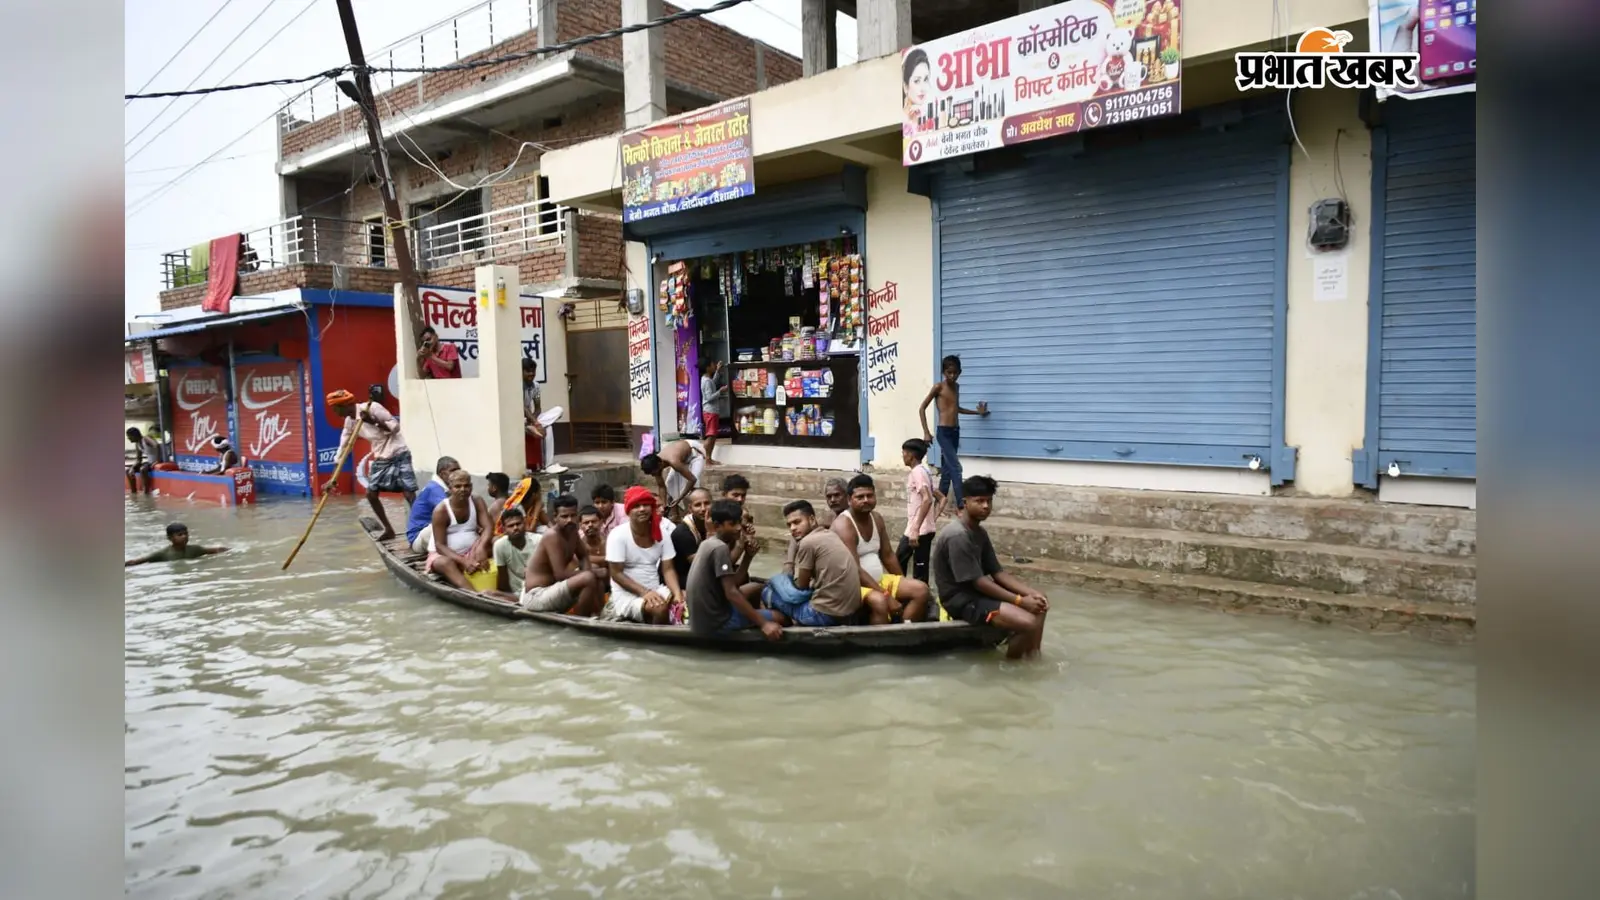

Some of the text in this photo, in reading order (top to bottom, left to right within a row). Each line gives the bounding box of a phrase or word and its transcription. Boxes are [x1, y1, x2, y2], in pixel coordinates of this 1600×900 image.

[1017, 15, 1098, 57] कॉस्मेटिक
[936, 35, 1012, 92] आभा
[1048, 52, 1060, 69] &
[1014, 75, 1053, 102] गिफ्ट
[1057, 64, 1098, 91] कॉर्नर
[1105, 86, 1173, 111] 9117004756
[1020, 116, 1053, 136] अवधेश
[1105, 101, 1172, 124] 7319671051
[622, 139, 651, 166] मिल्की
[651, 134, 682, 161] किराना
[684, 130, 693, 151] &
[694, 123, 726, 148] जेनरल
[727, 111, 750, 138] स्टोर
[867, 280, 898, 311] मिल्की
[628, 316, 650, 340] मिल्की
[868, 309, 900, 337] किराना
[868, 342, 898, 369] जेनरल
[185, 378, 218, 395] RUPA
[252, 375, 294, 393] RUPA
[868, 365, 897, 396] स्टोर्स
[250, 410, 292, 459] Jon
